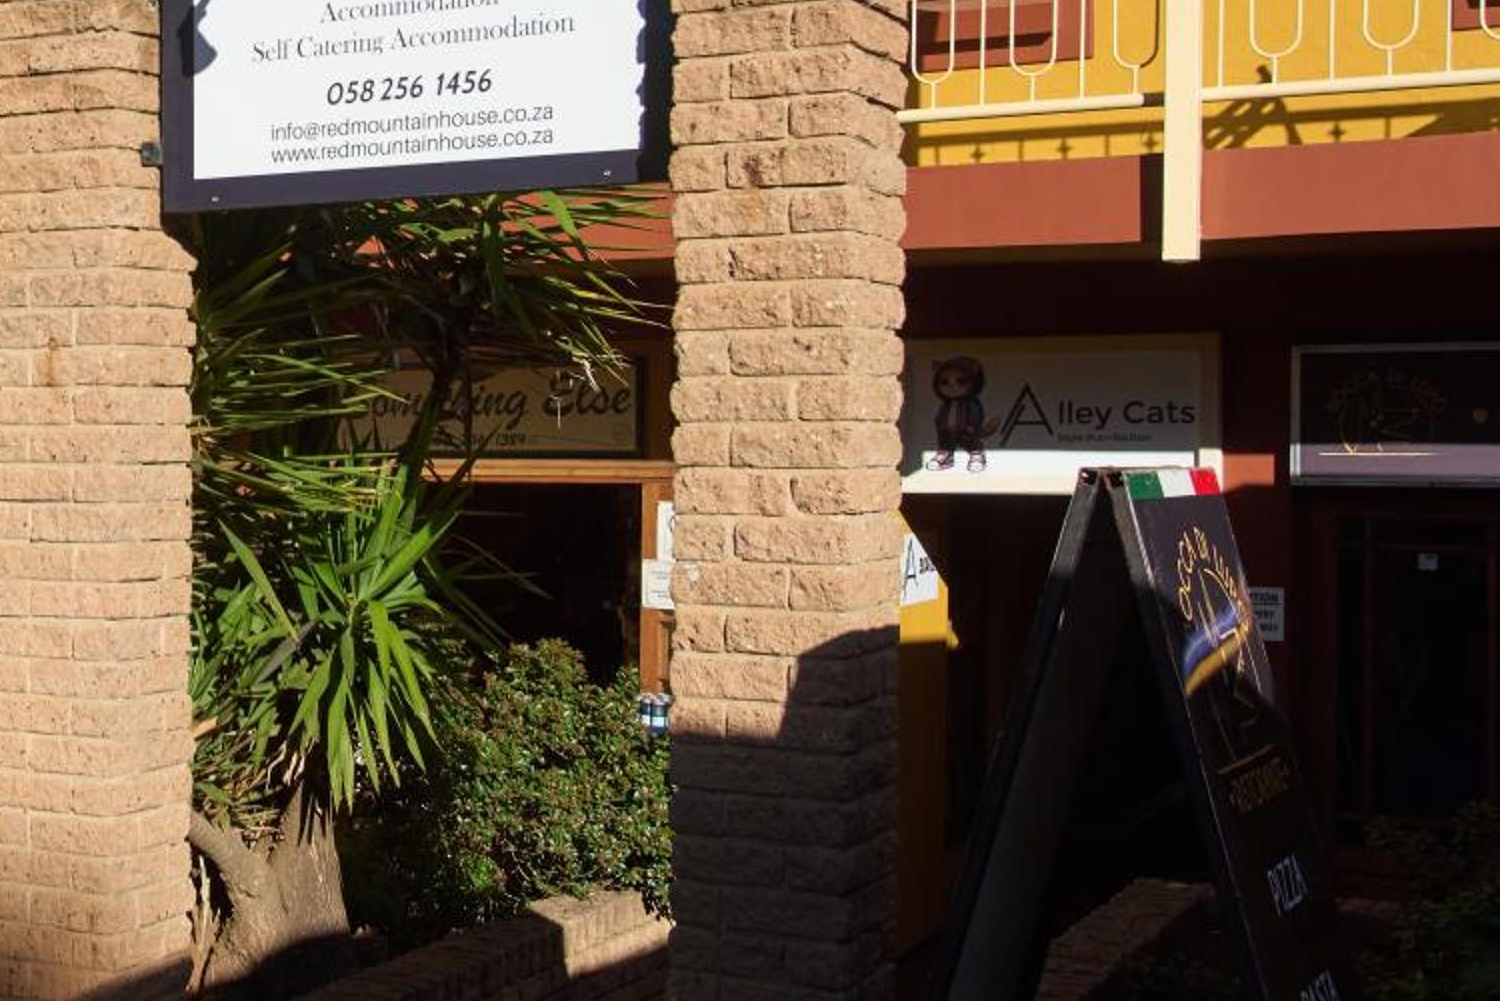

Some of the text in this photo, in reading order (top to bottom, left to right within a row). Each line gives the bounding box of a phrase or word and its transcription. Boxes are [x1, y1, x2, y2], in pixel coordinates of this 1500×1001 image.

[252, 11, 576, 63] Self Catering Accommodation
[327, 68, 493, 105] 058 256 1456
[271, 105, 553, 142] info@redmountainhouse.co.za
[271, 128, 553, 164] www.redmountainhouse.co.za
[1123, 400, 1196, 425] Cats
